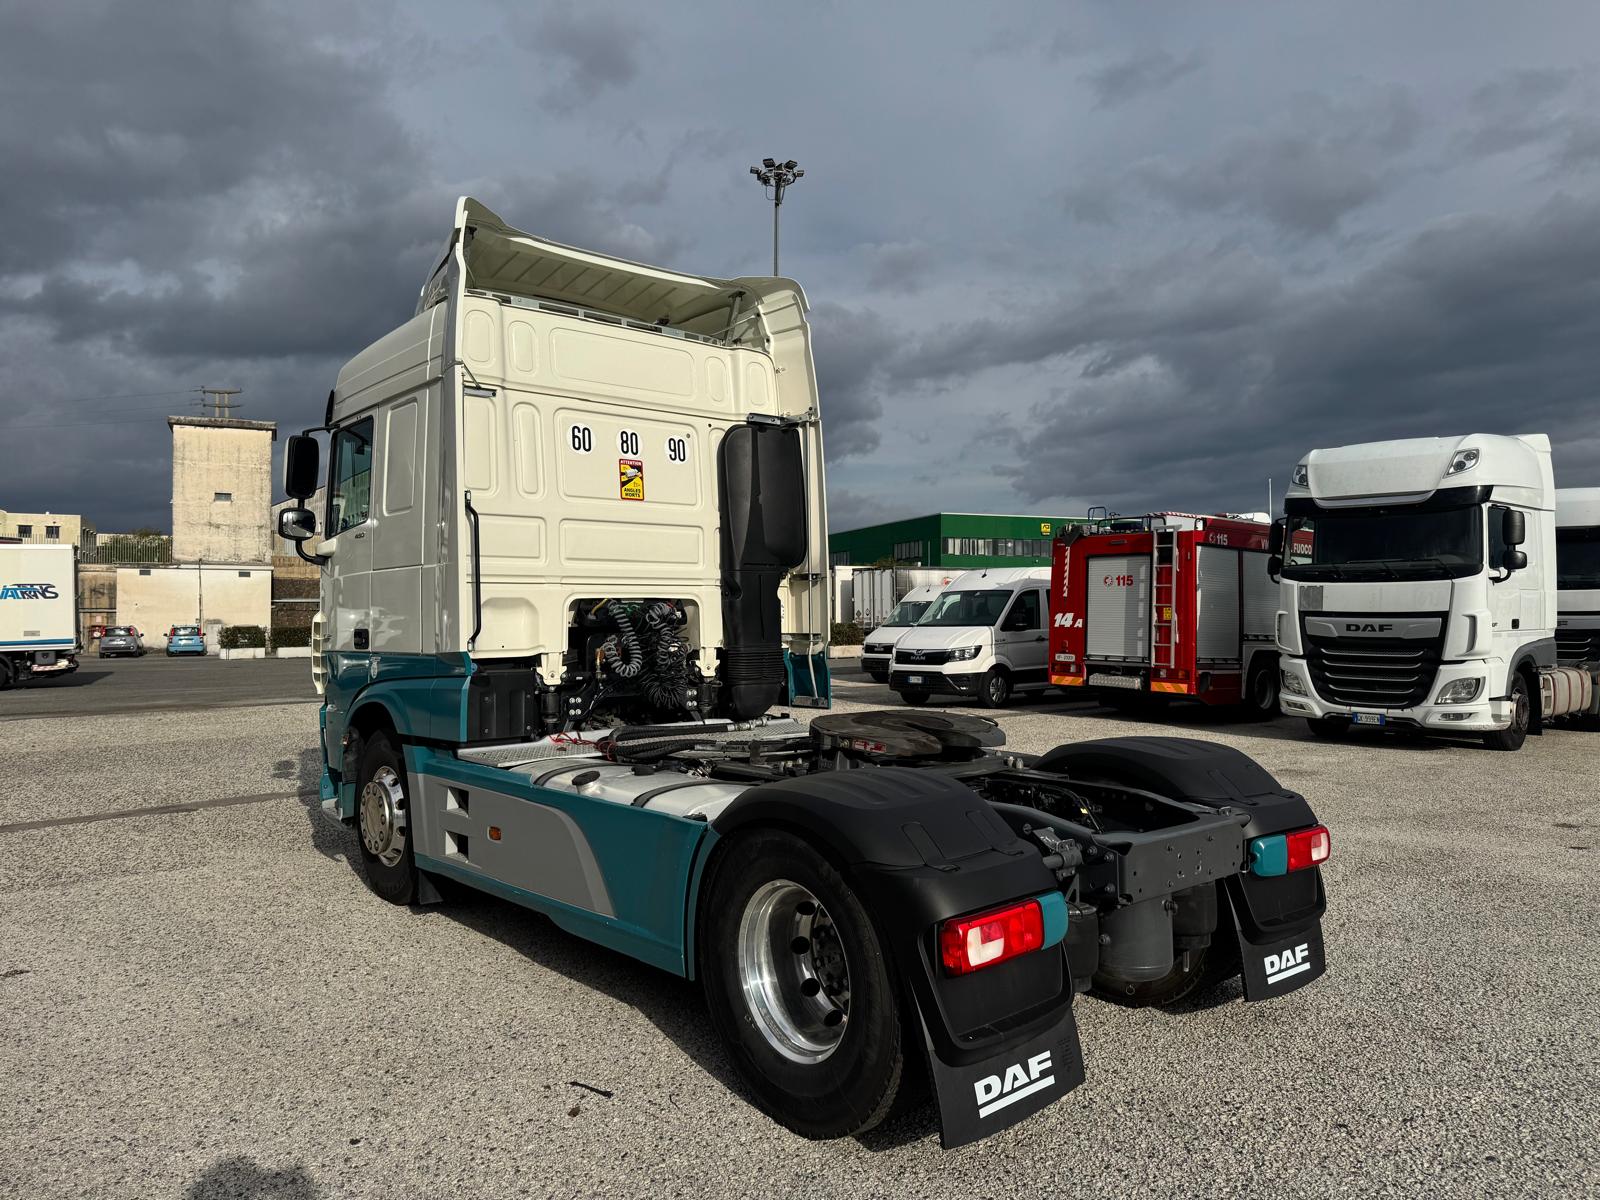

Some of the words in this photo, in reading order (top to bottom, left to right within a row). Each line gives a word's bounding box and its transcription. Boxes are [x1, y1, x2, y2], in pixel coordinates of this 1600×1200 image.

[571, 425, 592, 452] 60
[620, 431, 639, 455] 80
[668, 438, 686, 462] 90
[1217, 533, 1228, 545] 115
[1293, 543, 1312, 555] FUOCO
[1115, 575, 1134, 586] 115
[1054, 613, 1075, 628] 14
[1074, 619, 1083, 628] A
[1346, 624, 1393, 633] DAF
[1263, 943, 1309, 976] DAF
[974, 1050, 1053, 1106] DAF
